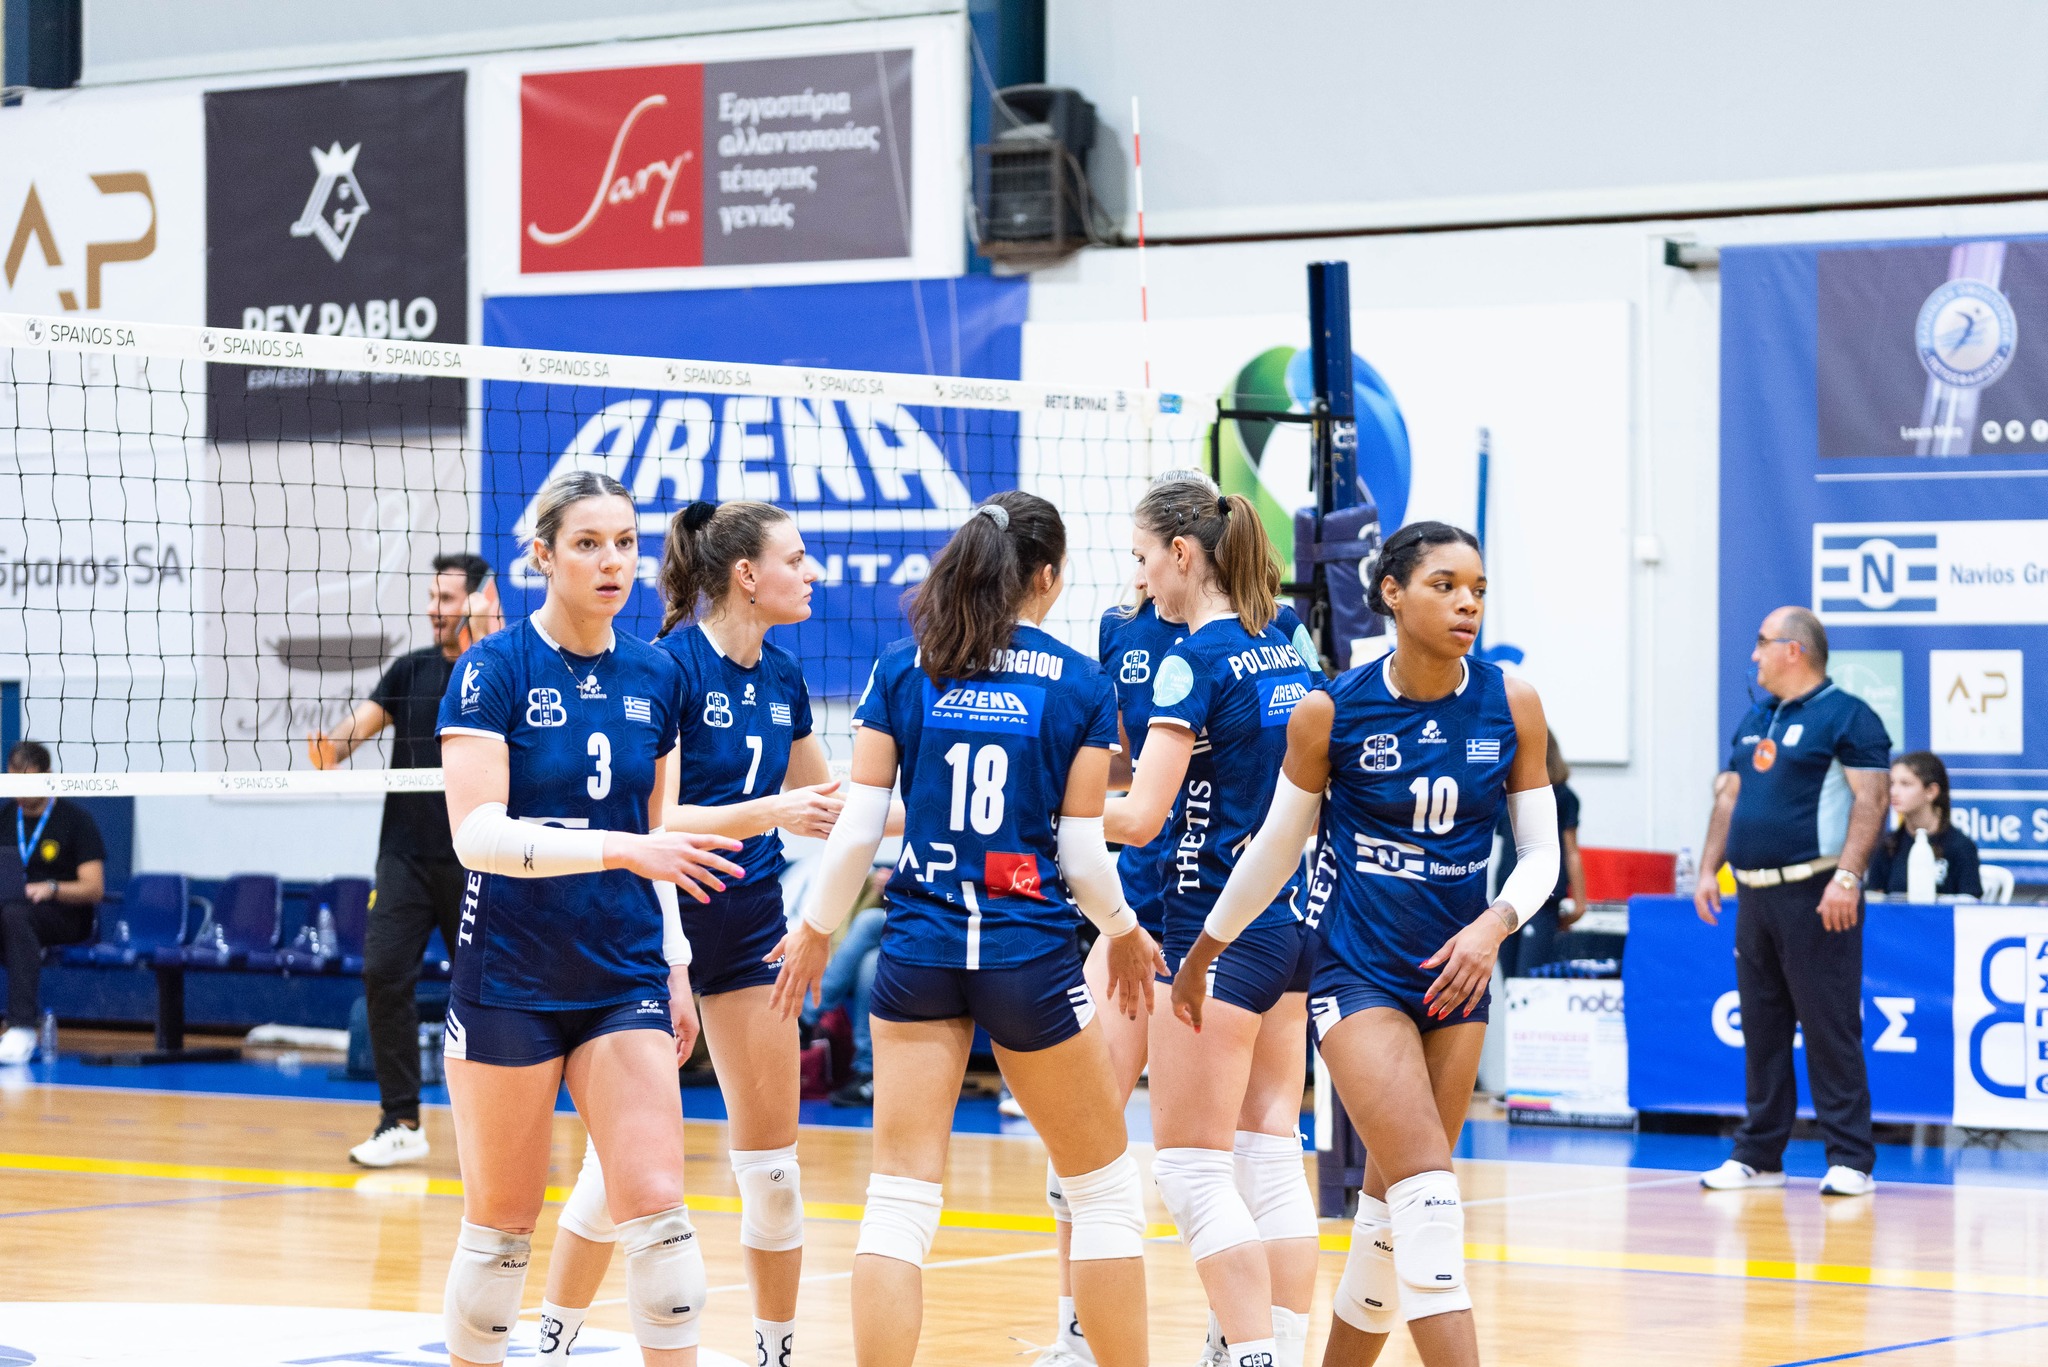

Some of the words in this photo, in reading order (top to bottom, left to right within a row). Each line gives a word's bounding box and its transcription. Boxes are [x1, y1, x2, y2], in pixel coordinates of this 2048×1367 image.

[717, 87, 851, 124] Εργαστήρια
[717, 163, 818, 197] τέταρτης
[717, 197, 795, 235] γενιάς
[317, 297, 438, 340] PABLO
[51, 324, 112, 346] SPANOS
[116, 329, 136, 348] SA
[223, 336, 281, 358] SPANOS
[285, 340, 304, 359] SA
[386, 347, 440, 367] SPANOS
[444, 351, 462, 368] SA
[538, 357, 591, 377] SPANOS
[594, 361, 610, 378] SA
[683, 366, 732, 386] SPANOS
[736, 371, 752, 387] SA
[820, 375, 866, 393] SPANOS
[869, 380, 885, 395] SA
[950, 384, 993, 401] SPANOS
[996, 387, 1012, 402] SA
[512, 396, 978, 533] ARENA
[0, 546, 121, 598] Spanos
[134, 543, 184, 585] SA
[1950, 562, 2015, 585] Navios
[933, 688, 1029, 716] ARENA
[1268, 681, 1310, 708] ARENA
[931, 710, 963, 719] CAR
[969, 714, 1028, 725] RENTAL
[1267, 708, 1285, 717] CAR
[586, 731, 612, 800] 3
[742, 736, 763, 795] 7
[61, 778, 103, 792] SPANOS
[105, 778, 119, 791] SA
[233, 776, 272, 789] SPANOS
[276, 776, 289, 789] SA
[397, 773, 432, 788] SPANOS
[944, 742, 1009, 835] 18
[1409, 775, 1459, 835] 10
[1951, 806, 2022, 843] Blue
[1176, 779, 1212, 895] THETIS
[1430, 861, 1466, 876] Navios
[1424, 1196, 1457, 1208] MIKASA
[662, 1232, 692, 1246] MIKASA
[500, 1259, 528, 1269] MIKASA
